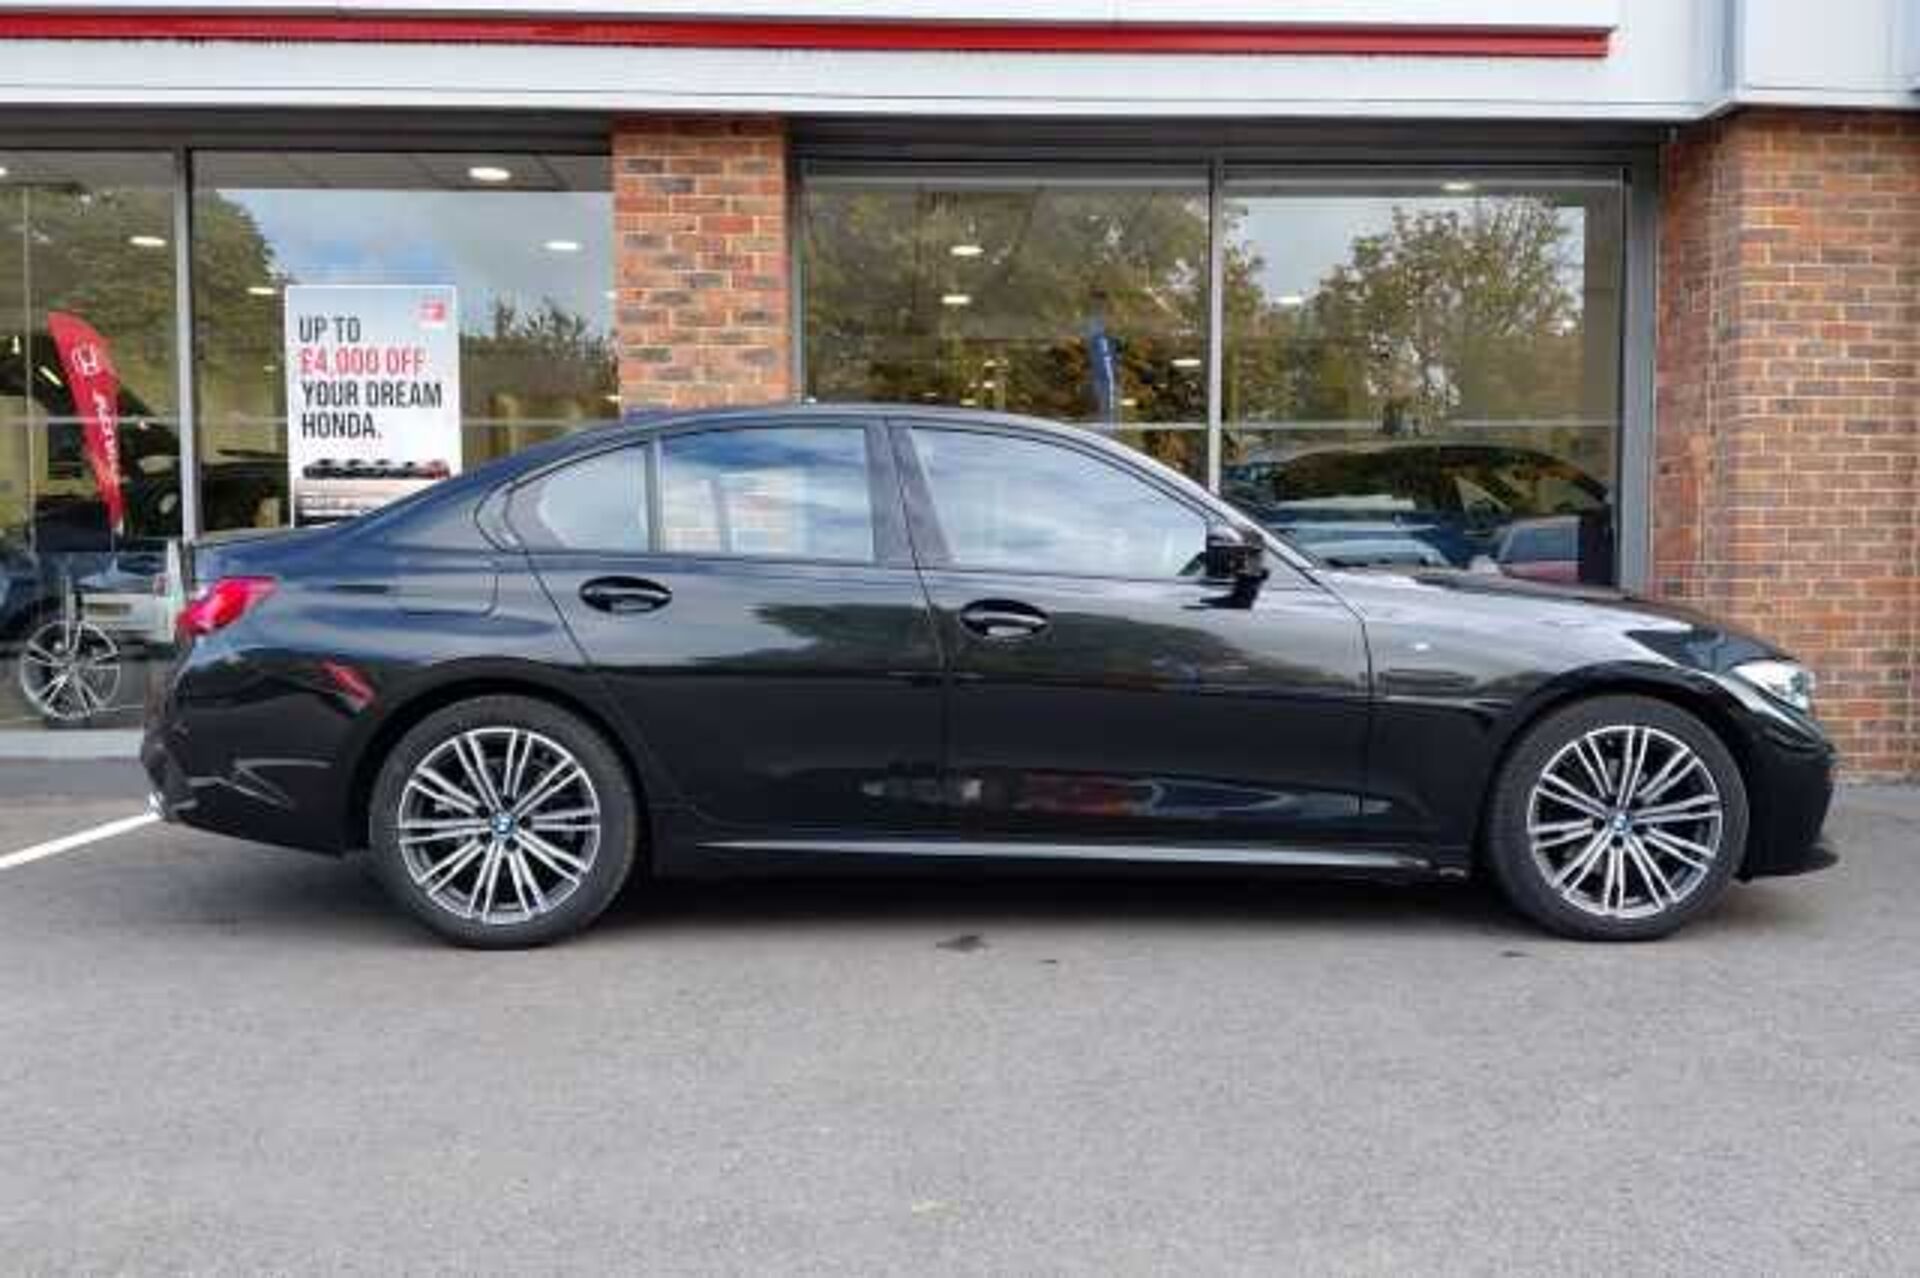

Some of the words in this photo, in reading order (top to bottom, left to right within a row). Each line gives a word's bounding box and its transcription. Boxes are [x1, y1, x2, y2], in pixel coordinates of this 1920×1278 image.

[299, 317, 326, 343] UP
[335, 317, 361, 343] TO
[300, 347, 379, 377] £4,000
[386, 347, 424, 375] OFF
[302, 381, 358, 407] YOUR
[365, 381, 442, 408] DREAM
[302, 412, 382, 439] HONDA.
